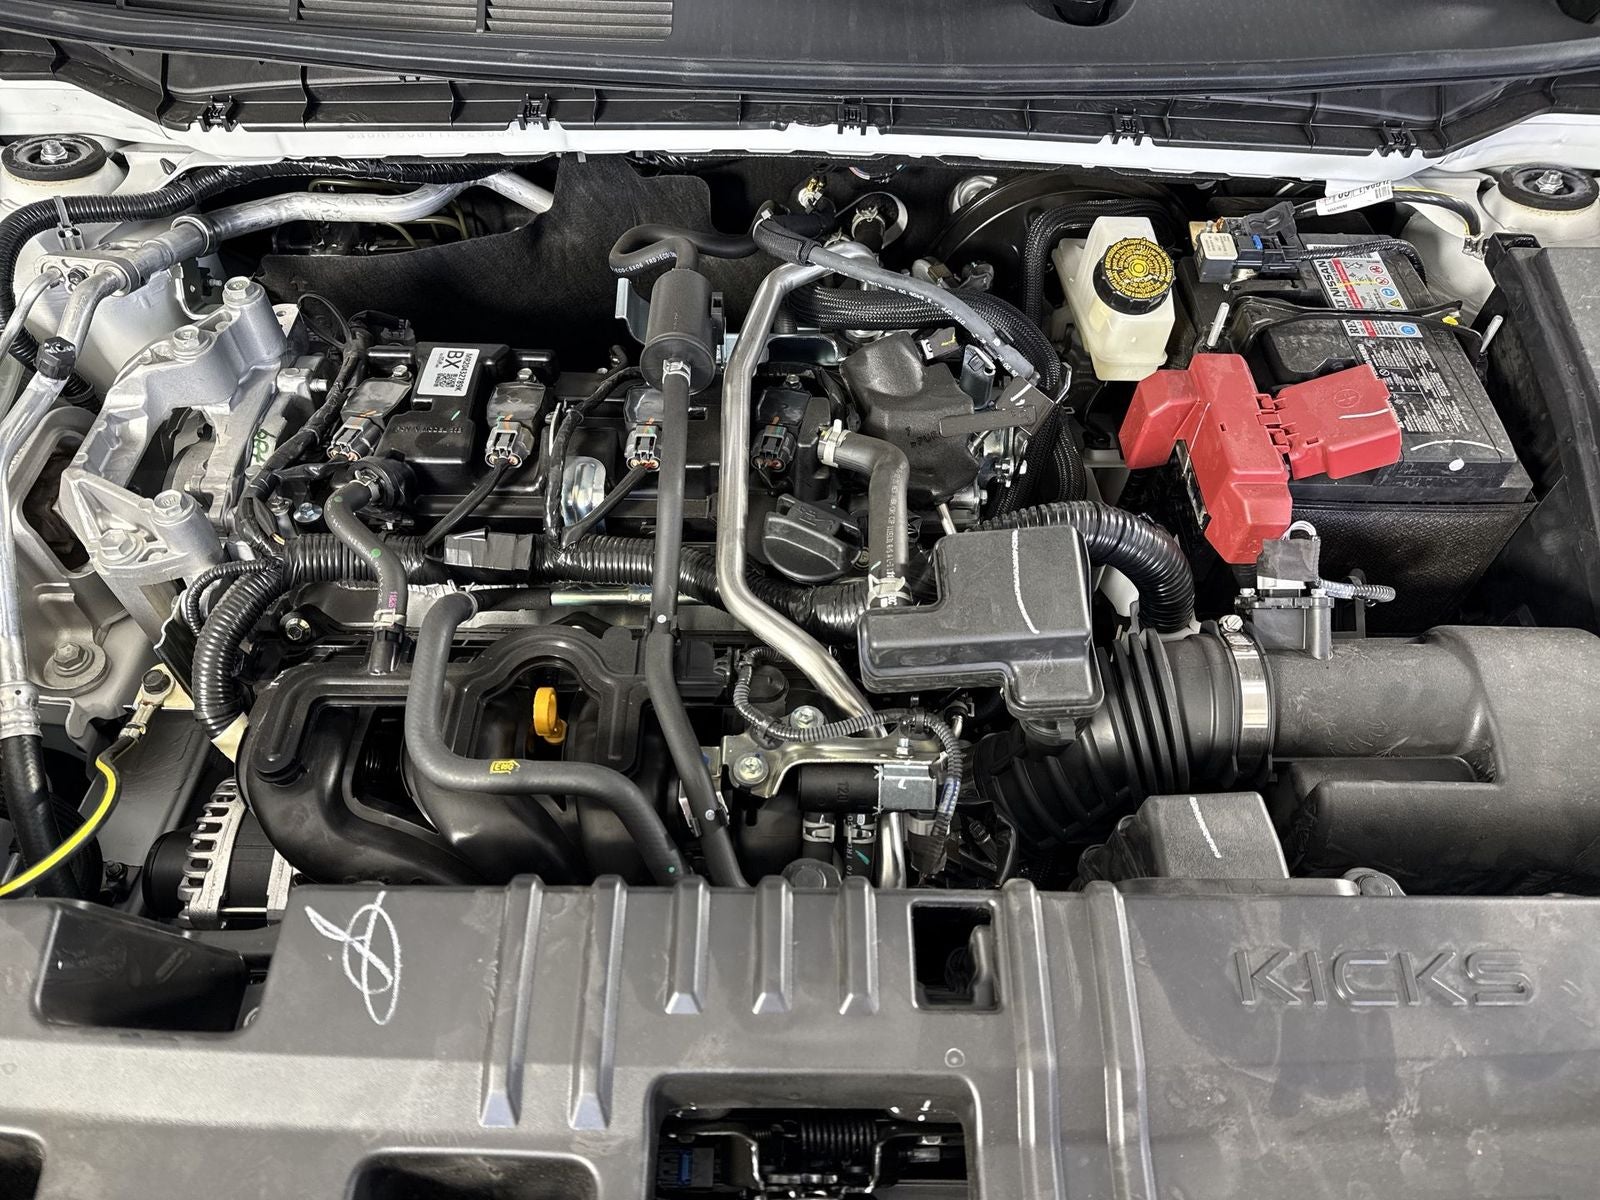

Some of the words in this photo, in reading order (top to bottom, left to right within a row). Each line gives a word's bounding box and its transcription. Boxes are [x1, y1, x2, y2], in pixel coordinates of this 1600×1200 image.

[1316, 260, 1342, 297] NISSAN
[441, 350, 465, 369] BX
[1234, 949, 1537, 1007] KICKS
